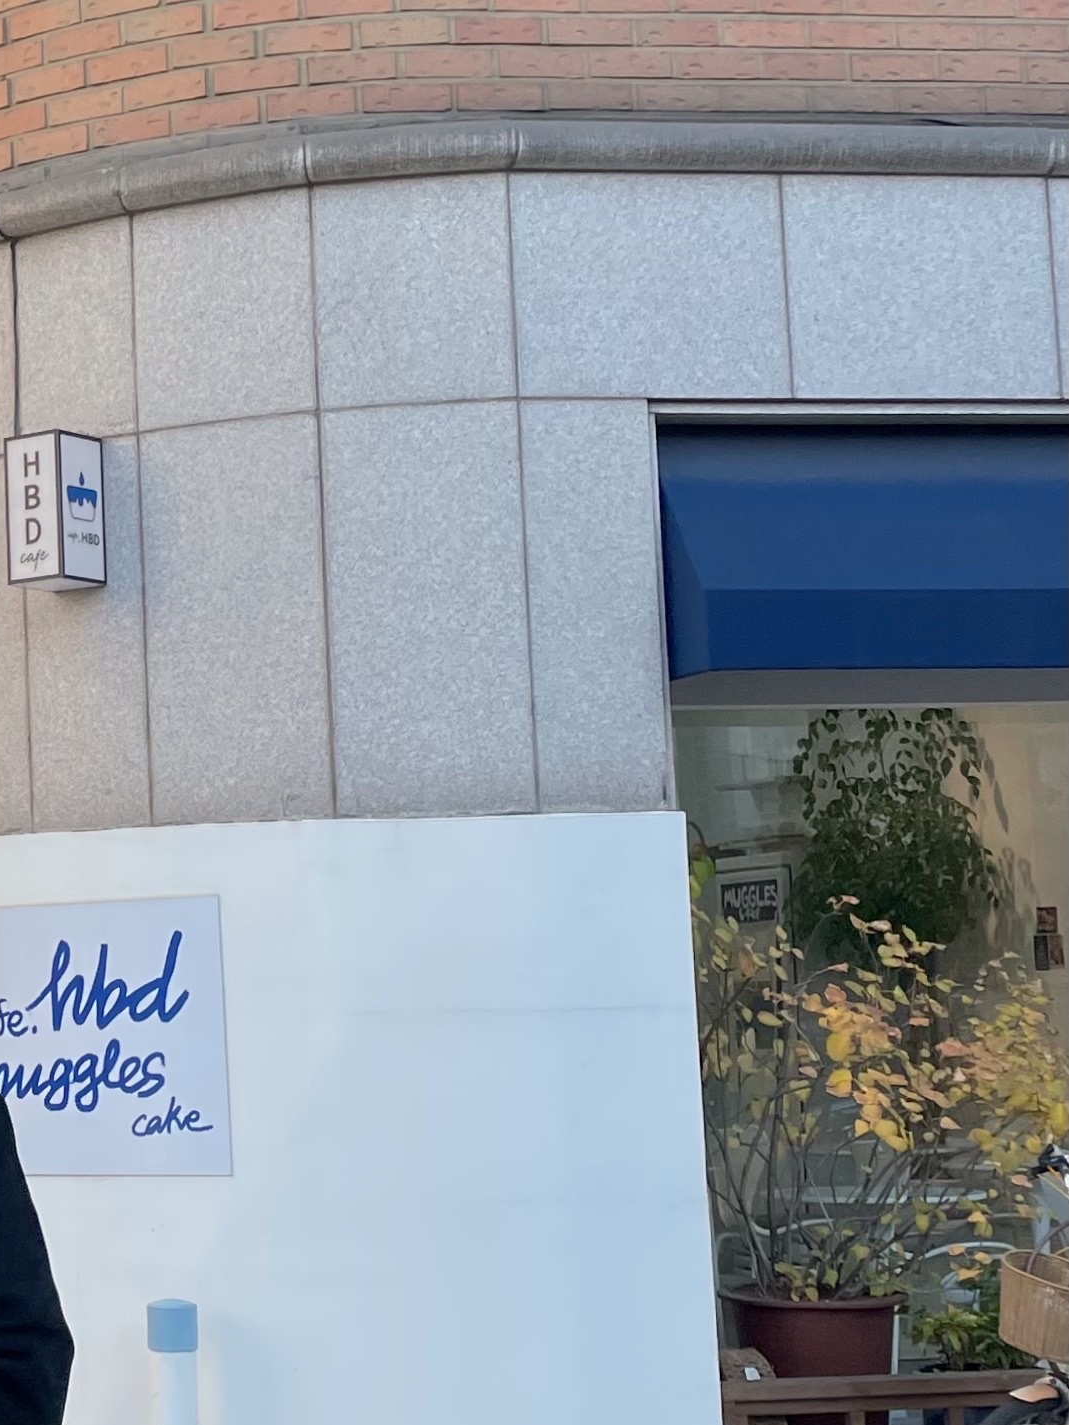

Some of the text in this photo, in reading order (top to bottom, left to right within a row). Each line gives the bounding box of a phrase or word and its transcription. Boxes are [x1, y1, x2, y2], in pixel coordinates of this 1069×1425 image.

[20, 549, 49, 571] cafe
[723, 885, 778, 909] MUGGLES
[131, 1096, 214, 1137] cake
